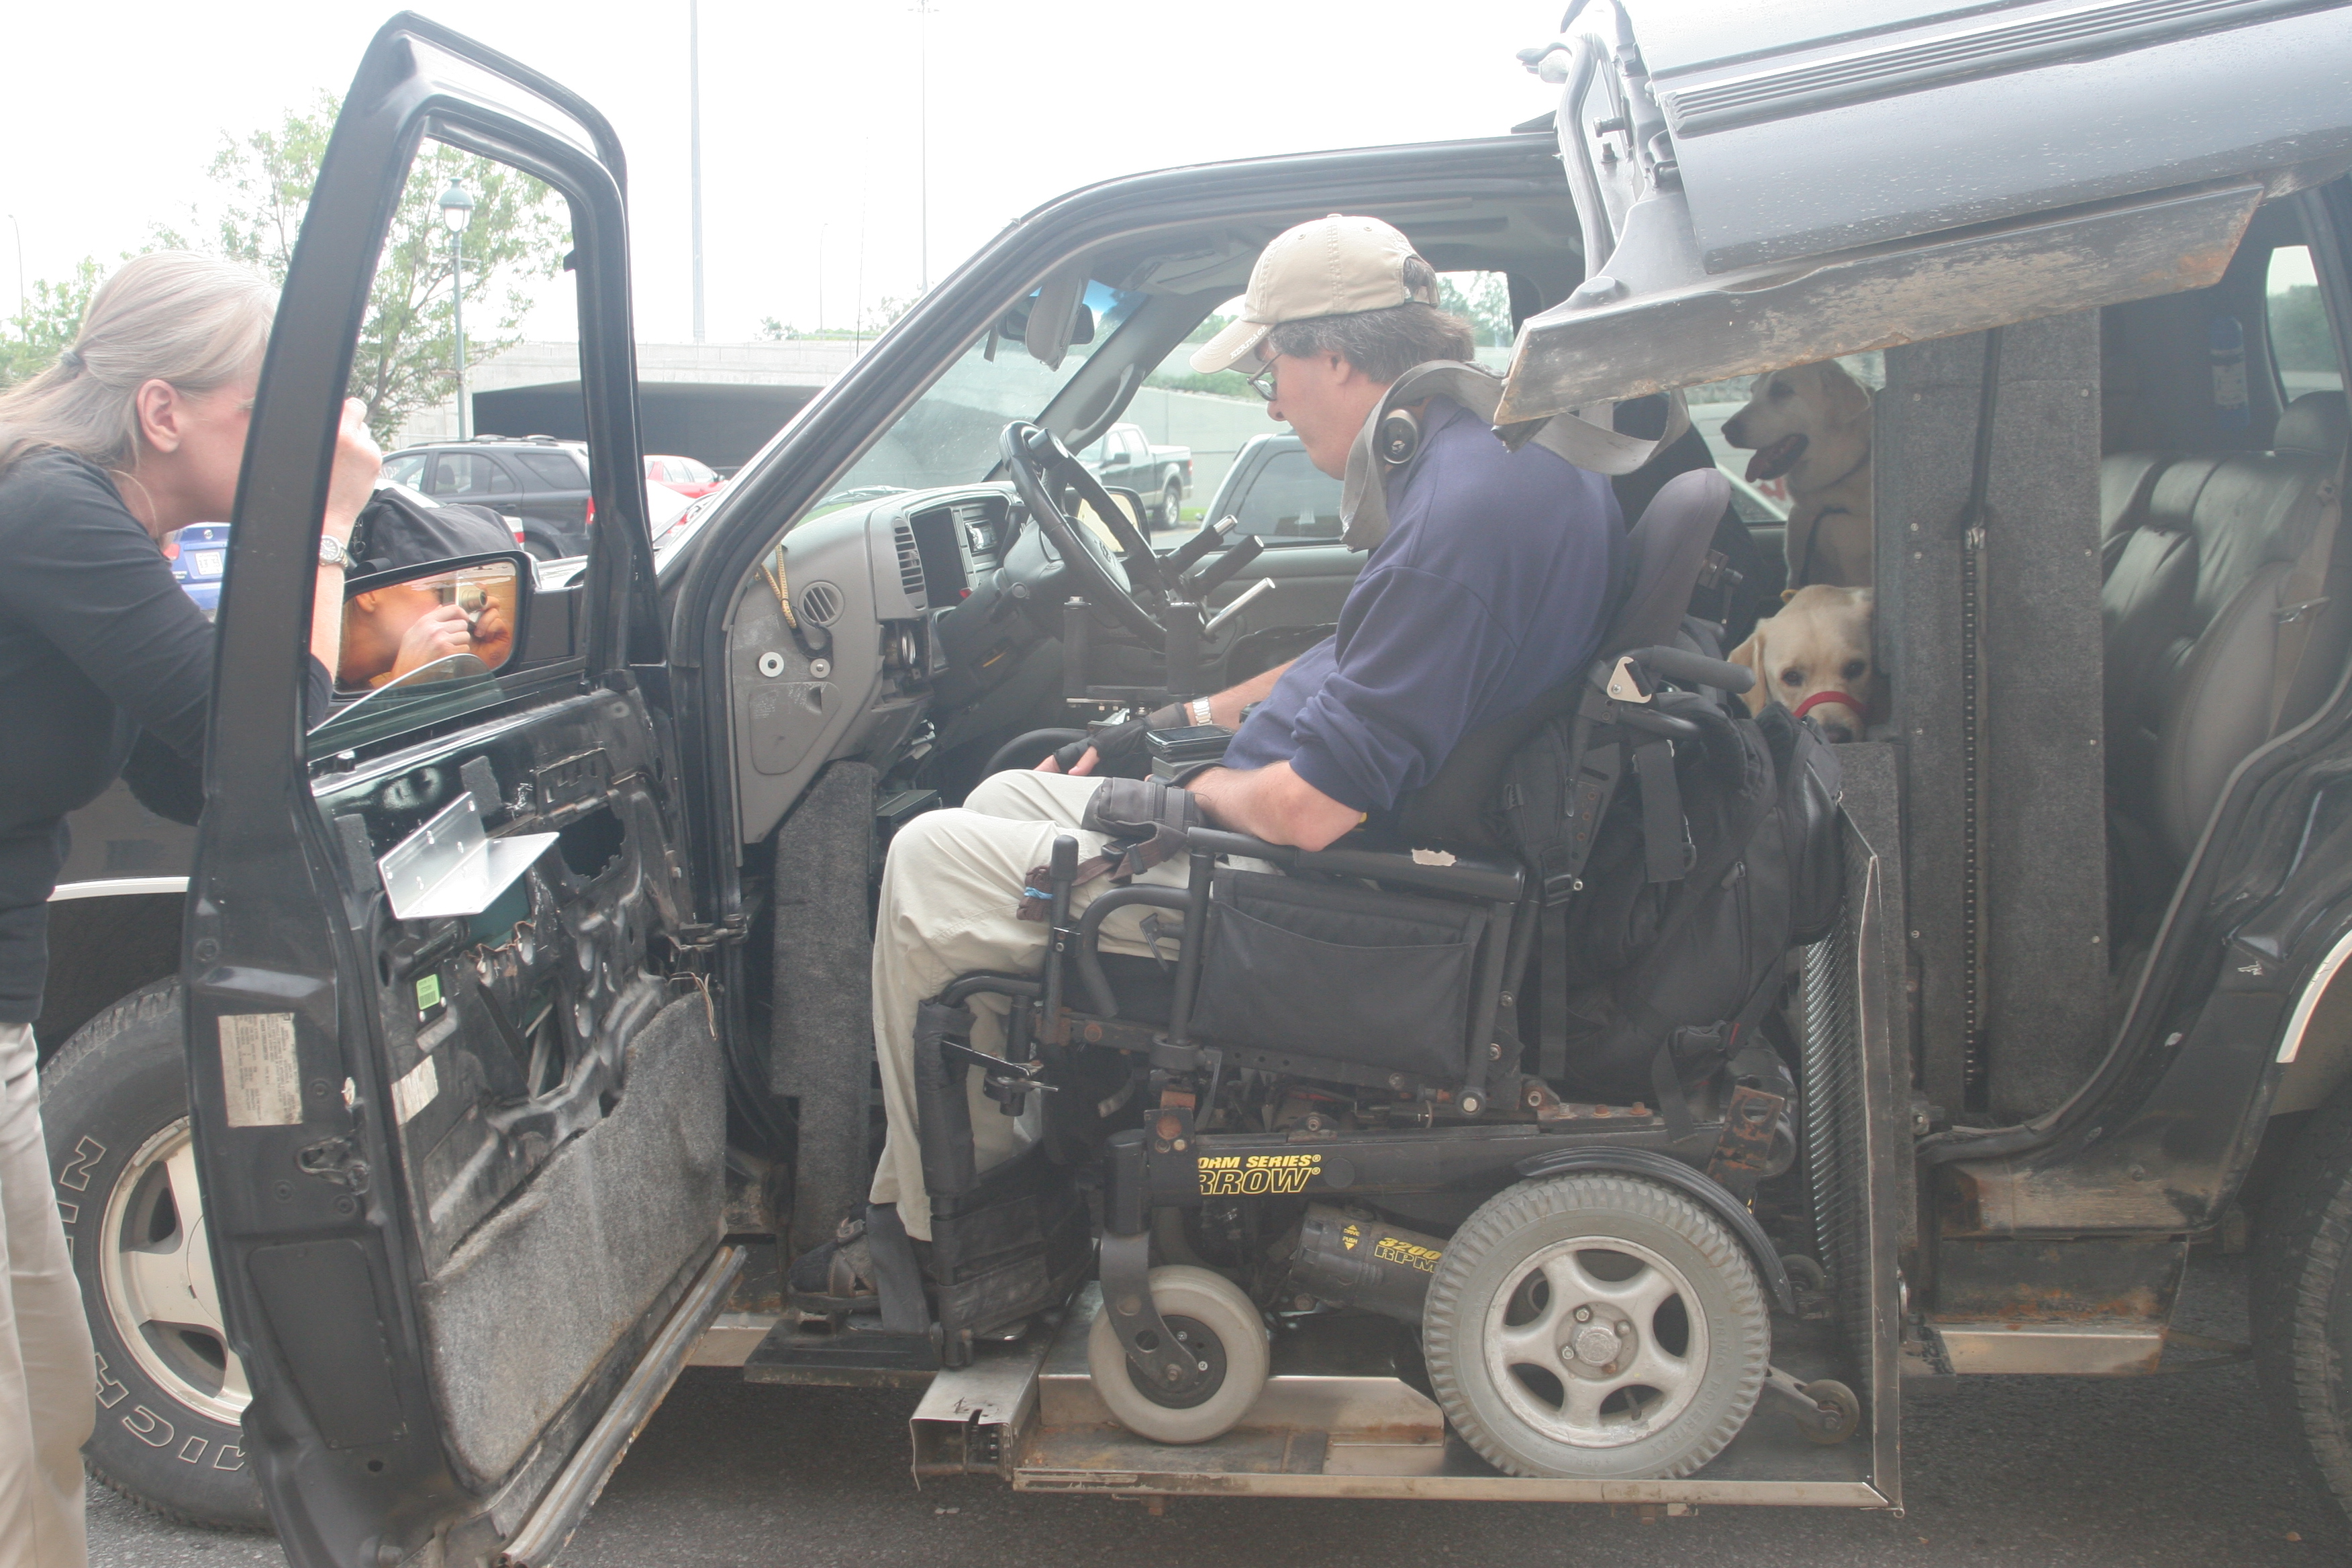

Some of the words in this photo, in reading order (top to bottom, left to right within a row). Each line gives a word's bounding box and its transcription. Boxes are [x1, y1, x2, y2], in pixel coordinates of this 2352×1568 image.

[1198, 1157, 1240, 1169] ORM
[1199, 1167, 1321, 1195] RROW®
[1342, 1236, 1359, 1244] PUSH
[1343, 1228, 1361, 1236] DRIVE
[1374, 1244, 1438, 1273] RPM
[1378, 1236, 1442, 1261] 3200
[1714, 1316, 1728, 1369] PRIMO
